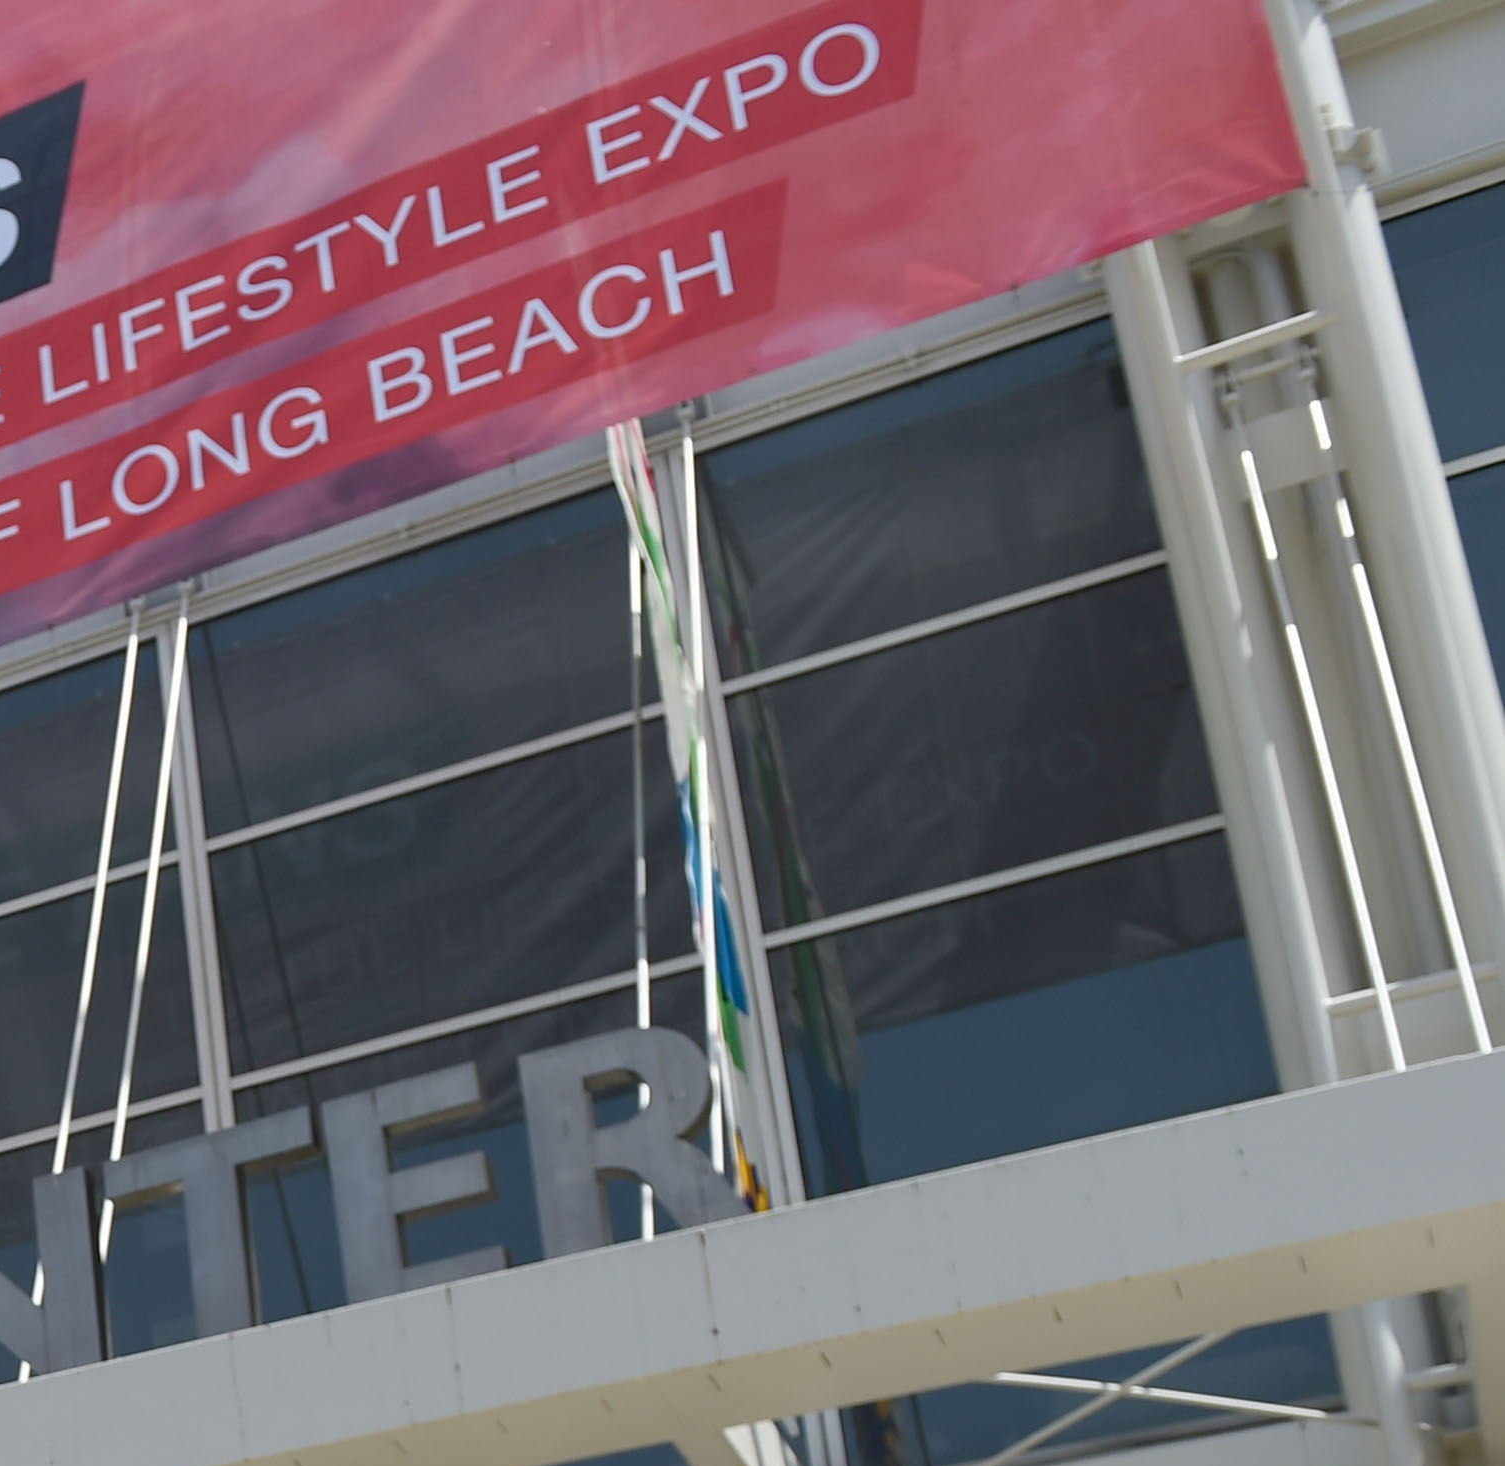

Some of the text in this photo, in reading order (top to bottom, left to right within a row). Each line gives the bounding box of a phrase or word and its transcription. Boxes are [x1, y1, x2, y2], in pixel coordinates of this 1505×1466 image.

[39, 145, 549, 404] LIFESTYLE
[585, 23, 880, 185] EXPO
[59, 386, 329, 541] LONG
[367, 230, 735, 423] BEACH
